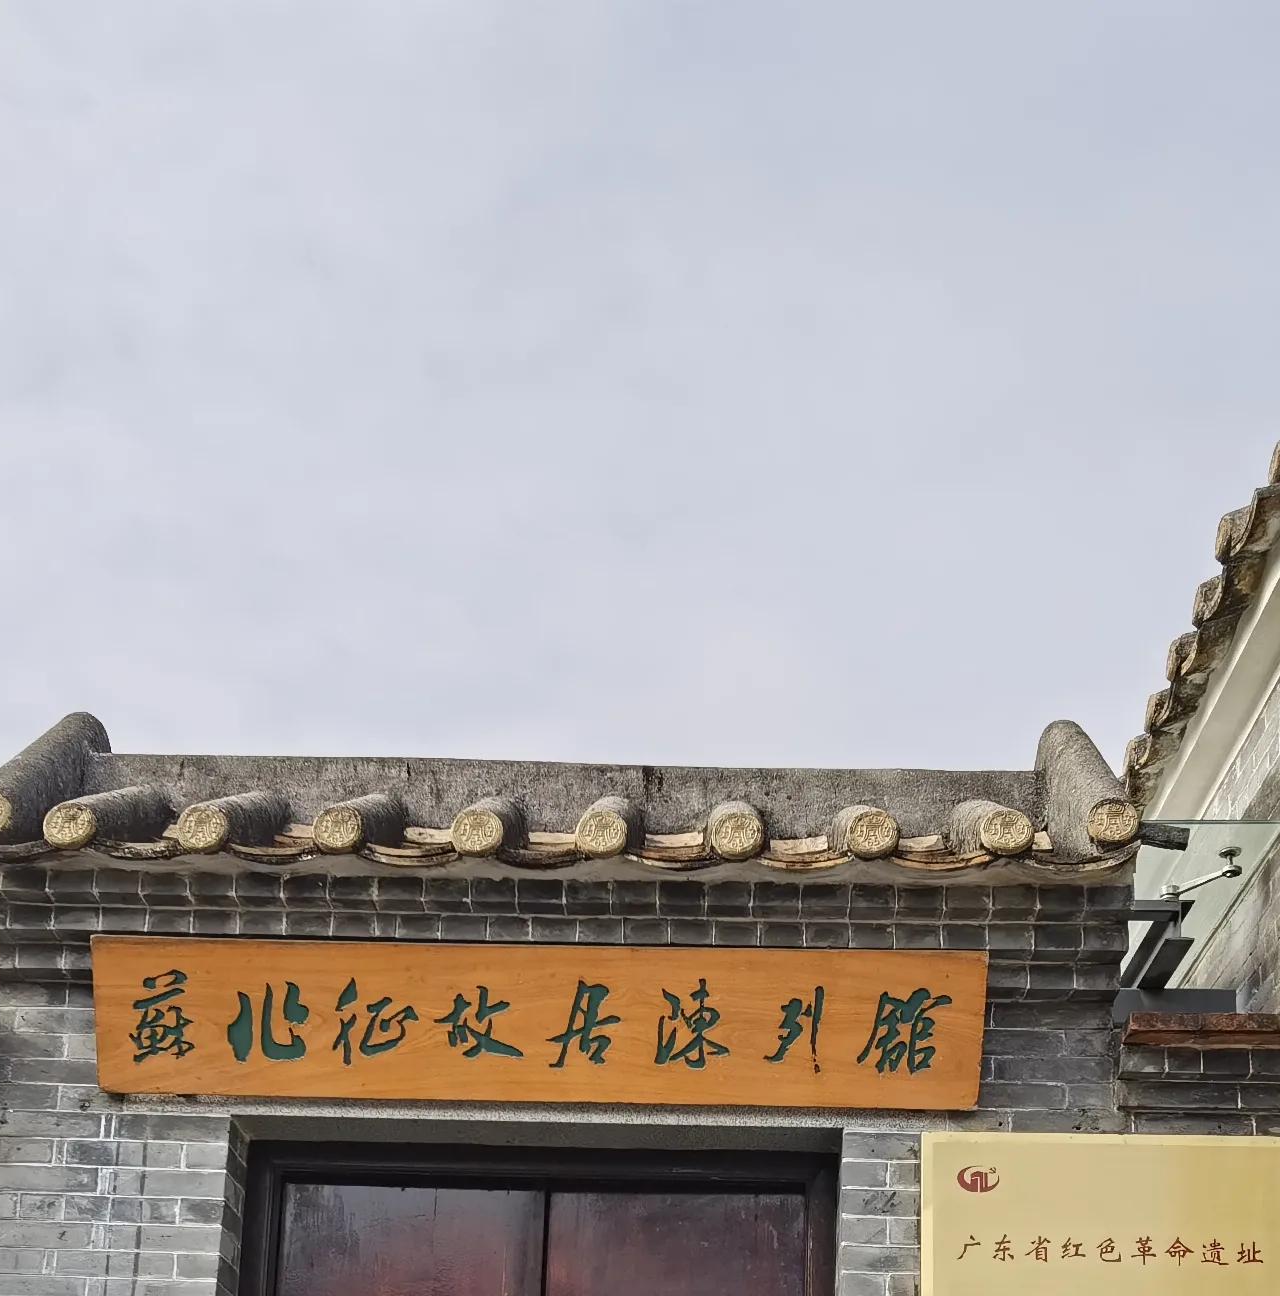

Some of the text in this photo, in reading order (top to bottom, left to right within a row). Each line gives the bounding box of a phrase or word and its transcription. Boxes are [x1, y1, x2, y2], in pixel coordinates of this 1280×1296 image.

[956, 1233, 1265, 1267] 广东省红色革命遗址
